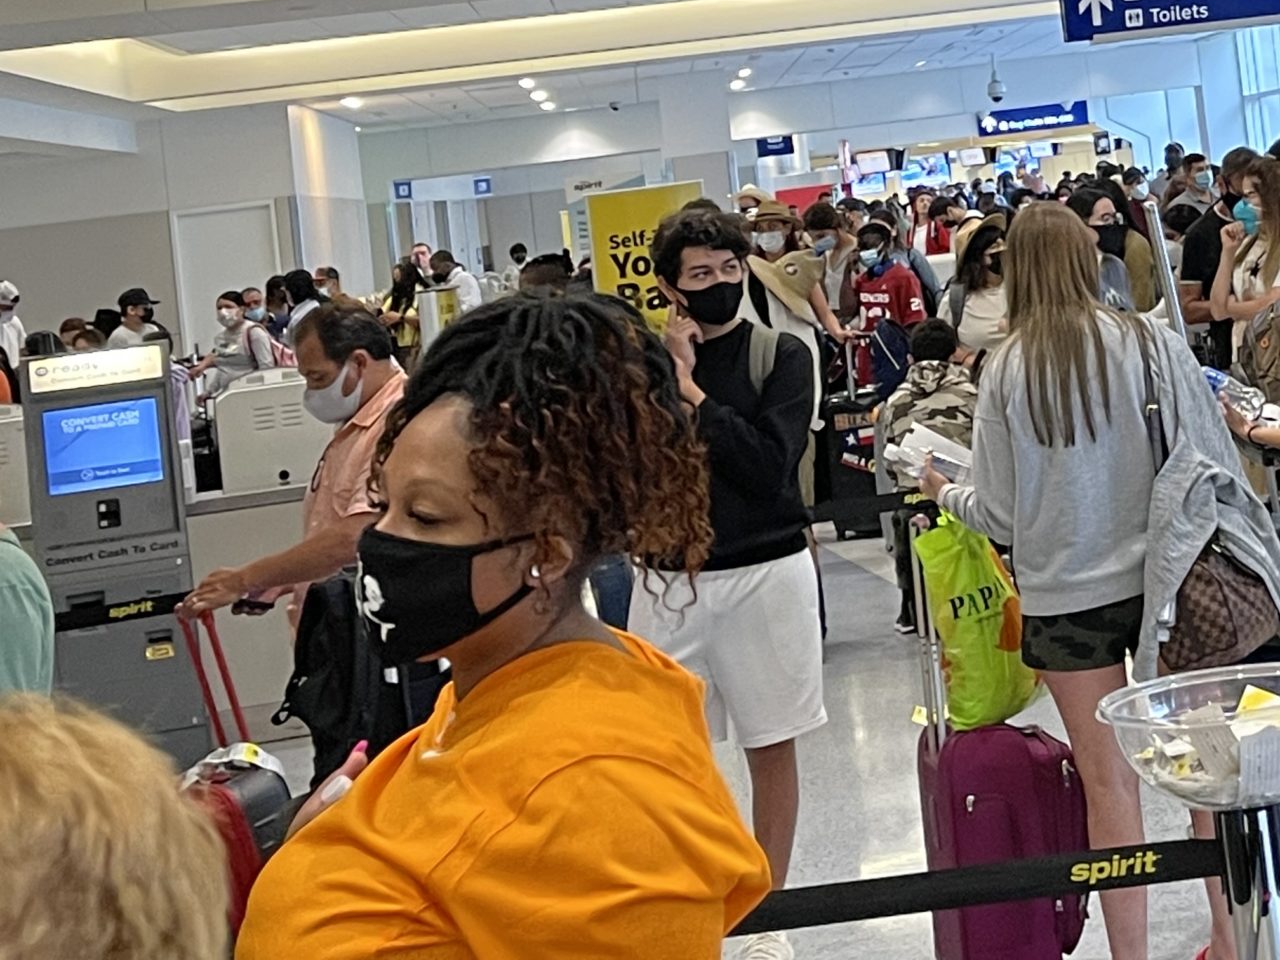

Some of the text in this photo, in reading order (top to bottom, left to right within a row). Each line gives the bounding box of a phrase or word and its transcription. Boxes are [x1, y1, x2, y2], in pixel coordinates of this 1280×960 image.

[1149, 4, 1209, 23] Toilets
[609, 229, 657, 250] Self-
[610, 251, 652, 279] Yo
[617, 282, 672, 311] Ba
[111, 410, 139, 421] CASH
[46, 552, 94, 567] Convert
[98, 548, 129, 560] Cash
[150, 540, 179, 552] Card
[109, 600, 154, 618] spirit
[1070, 850, 1158, 885] spirit
